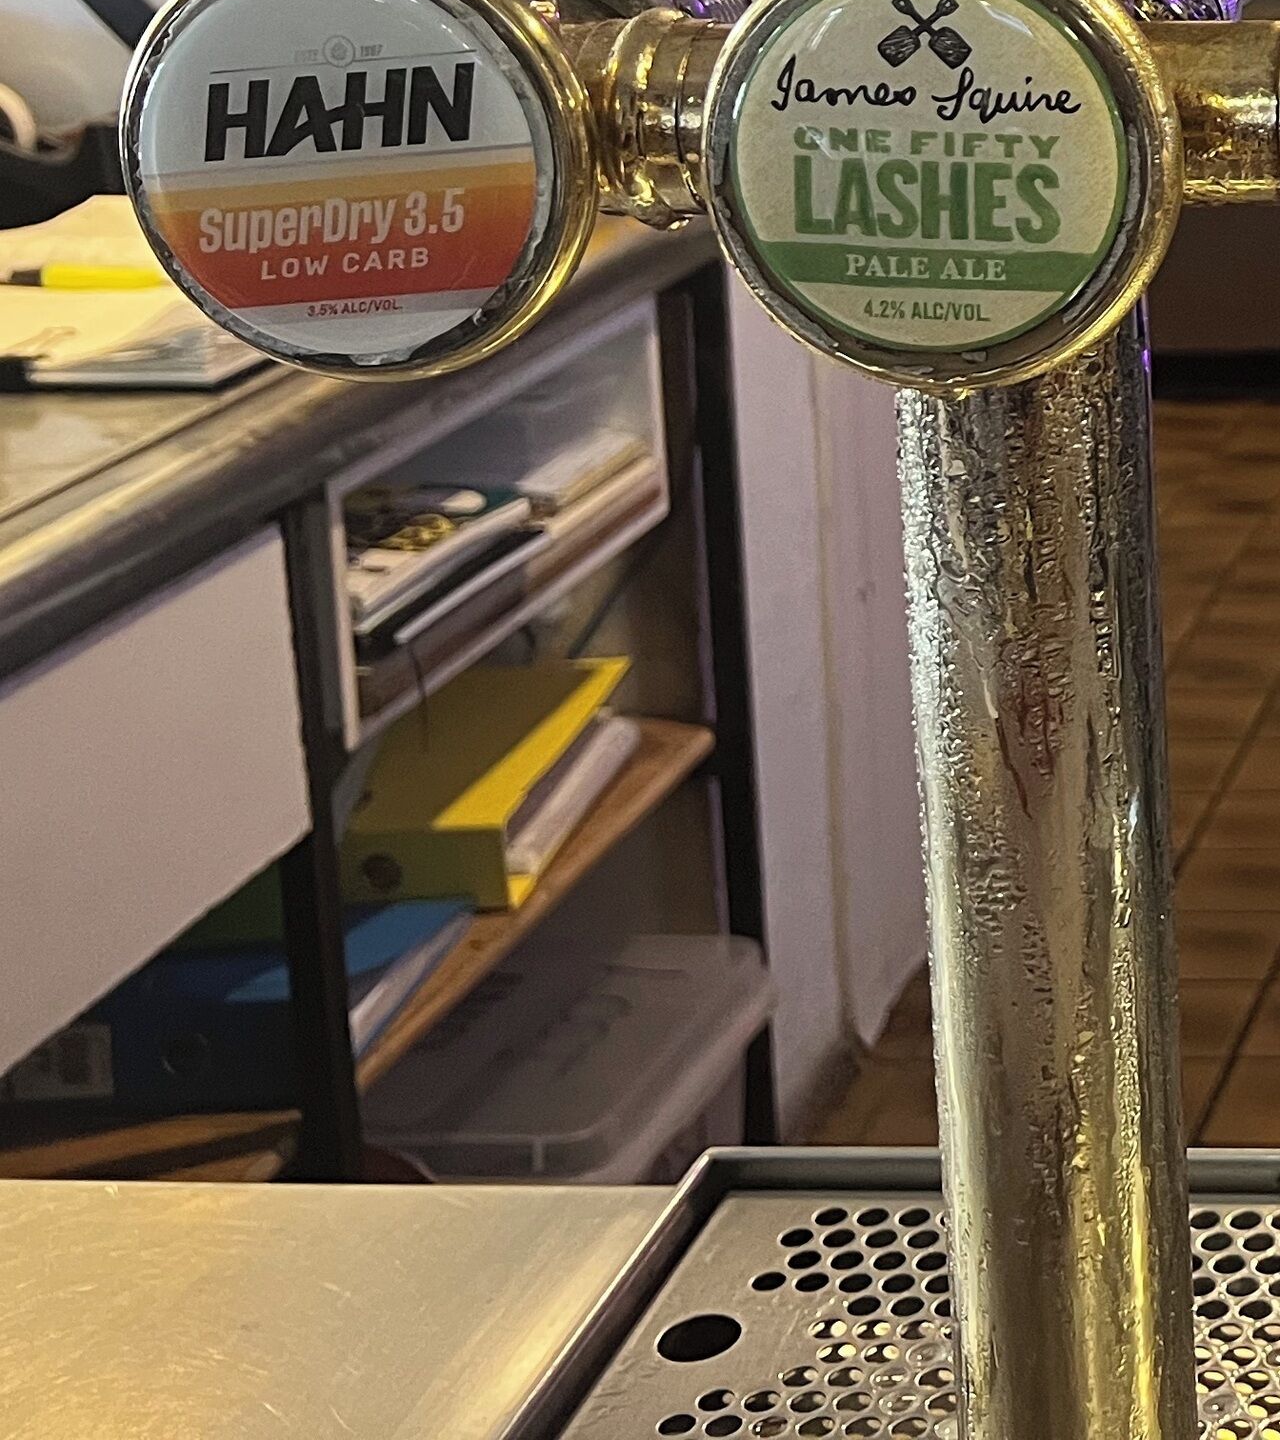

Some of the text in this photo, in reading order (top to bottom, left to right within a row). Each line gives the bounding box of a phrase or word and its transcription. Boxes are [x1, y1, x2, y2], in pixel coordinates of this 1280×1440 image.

[771, 54, 1082, 125] James Squire
[203, 61, 475, 163] HAHN
[793, 126, 1061, 160] ONE FIFTY
[793, 155, 1062, 245] LASHES
[200, 187, 465, 254] SuperDry 3.5
[260, 247, 430, 281] LOW CARB
[845, 253, 1008, 282] PALE ALE
[306, 303, 339, 318] 3.5%
[863, 298, 906, 320] 4.2%
